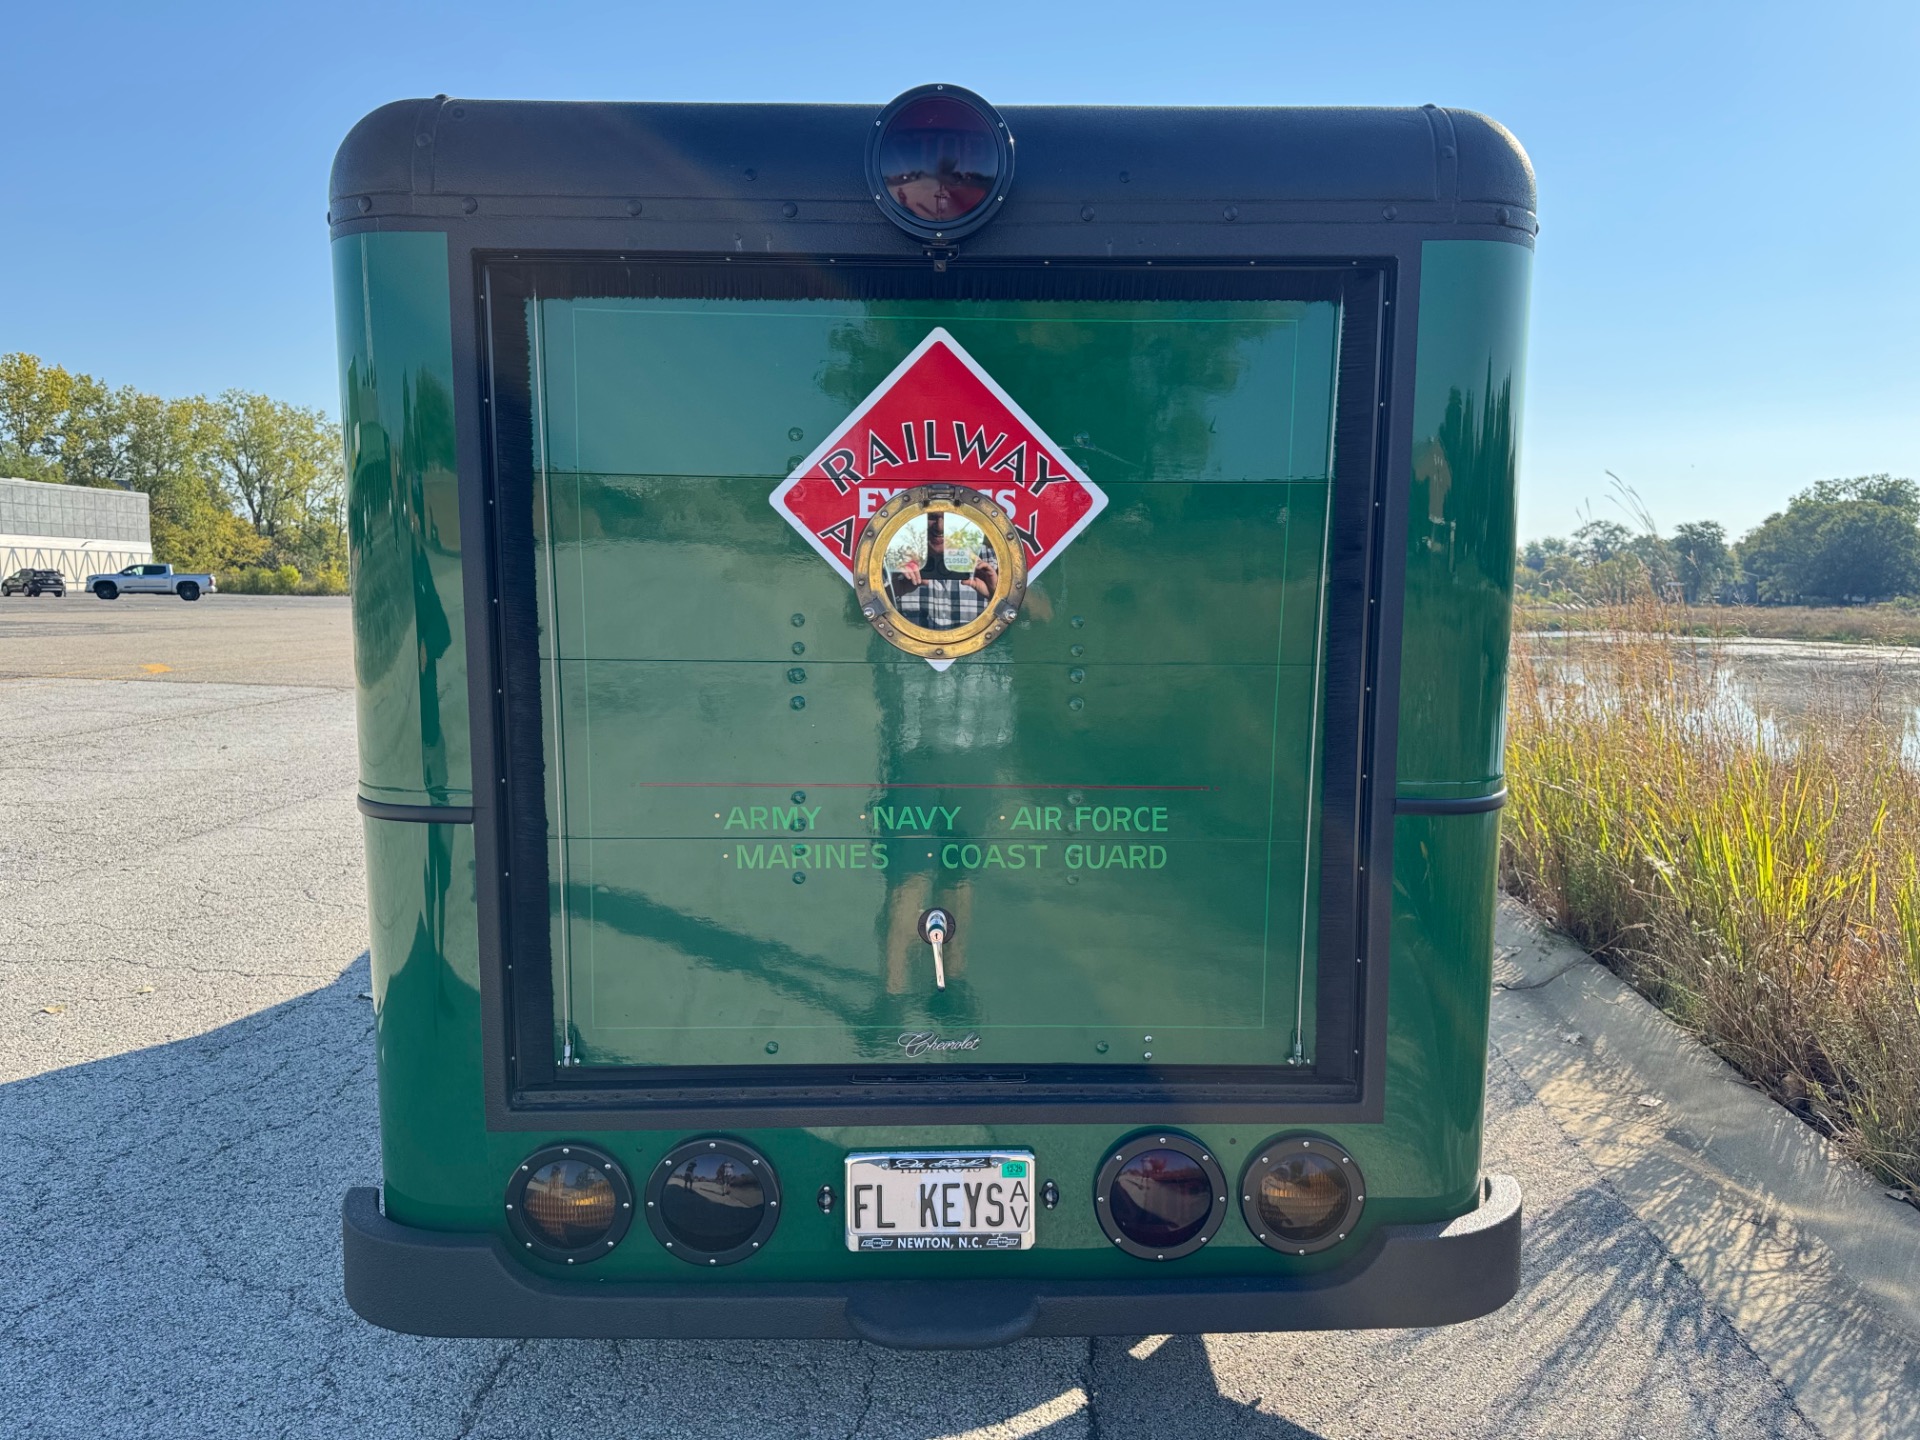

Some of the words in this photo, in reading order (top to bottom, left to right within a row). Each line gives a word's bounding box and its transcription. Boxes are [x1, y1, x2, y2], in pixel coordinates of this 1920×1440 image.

[818, 420, 1070, 498] RAILWAY
[724, 806, 822, 831] ARMY
[873, 806, 962, 831] NAVY
[1010, 806, 1062, 832] AIR
[1075, 806, 1169, 833] FORCE
[736, 843, 889, 870] MARINES
[941, 844, 1048, 870] COAST
[1065, 844, 1168, 870] GUARD
[897, 1031, 981, 1058] Chevrolet
[854, 1184, 896, 1229] FL
[920, 1182, 1005, 1228] KEYS
[897, 1237, 955, 1249] NEWTON,
[958, 1237, 983, 1248] N.C.
